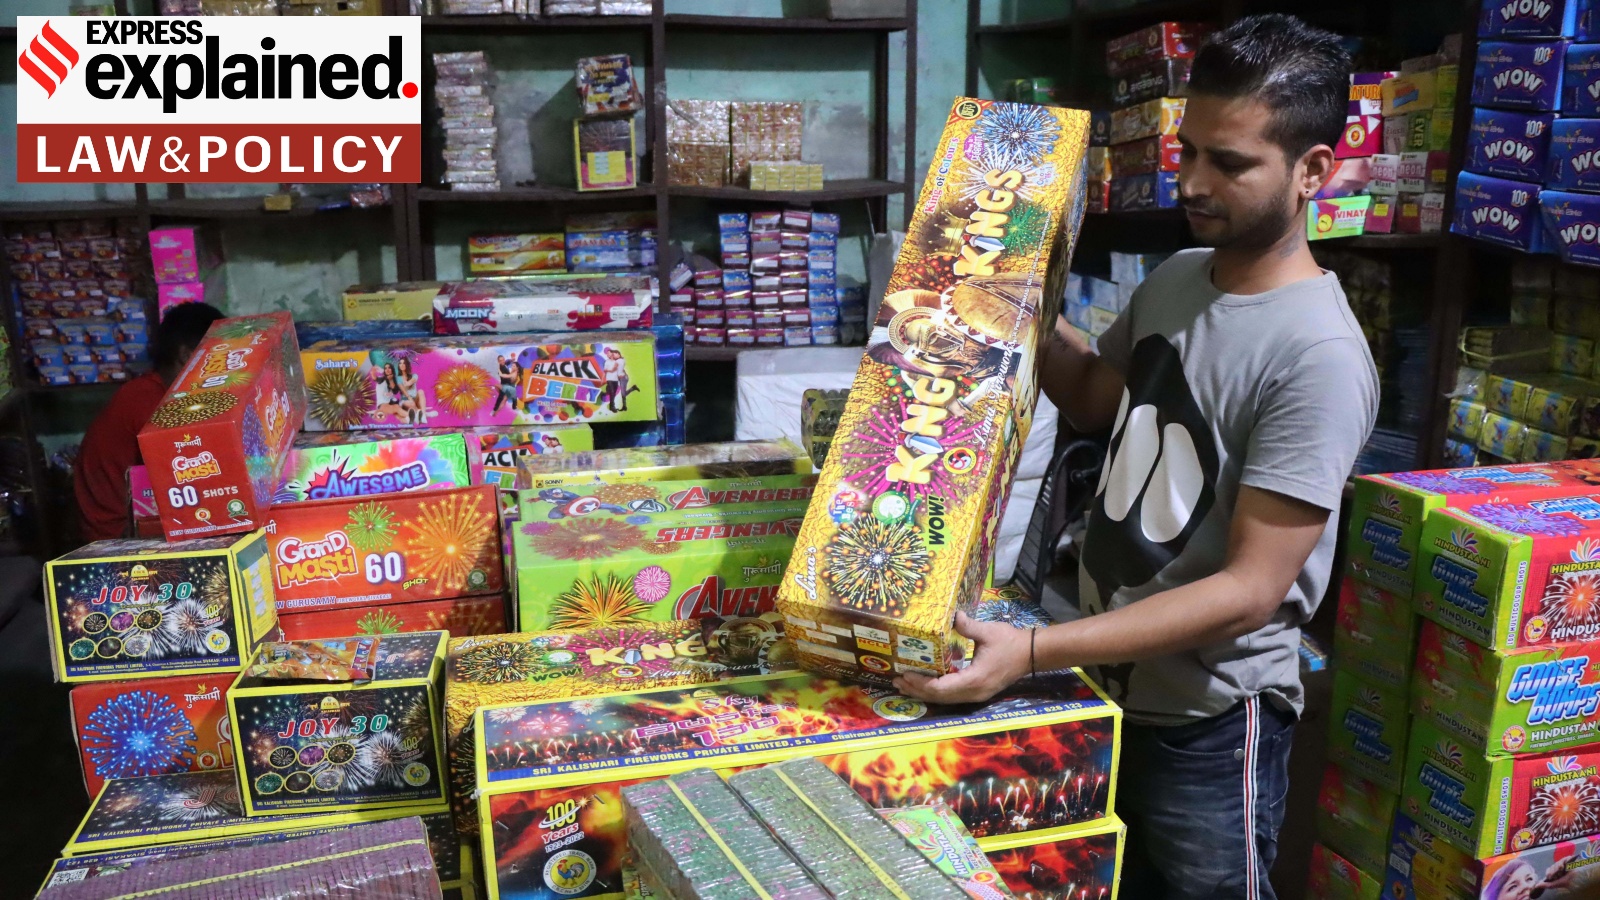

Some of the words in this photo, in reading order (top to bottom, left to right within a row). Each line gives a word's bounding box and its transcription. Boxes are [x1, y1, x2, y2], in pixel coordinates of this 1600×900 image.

[1533, 47, 1551, 65] 100
[1493, 68, 1542, 94] WOW
[1413, 117, 1425, 147] EVER
[1526, 120, 1542, 138] 100
[938, 137, 959, 175] Colours
[1484, 140, 1534, 164] WOW
[936, 176, 946, 187] of
[923, 188, 943, 214] King
[1511, 189, 1528, 207] 100
[953, 169, 1025, 277] KINGS
[1471, 206, 1520, 233] WOW
[445, 307, 491, 319] MOON
[315, 359, 359, 371] Sahara's
[532, 359, 600, 380] BLACK
[525, 376, 600, 404] BERRY
[885, 377, 956, 484] KING
[972, 405, 996, 450] Lima
[310, 464, 430, 499] AWESOME
[168, 485, 199, 508] 60
[202, 485, 239, 498] SHOTS
[927, 494, 946, 546] WOW!
[277, 530, 349, 567] GranD
[1434, 537, 1491, 568] HINDUSTAANI
[276, 548, 358, 590] Masti
[364, 551, 403, 584] 60
[794, 546, 818, 600] Lima's
[92, 584, 149, 605] JOY
[157, 581, 193, 601] 30
[403, 578, 430, 591] SHOT
[1509, 584, 1523, 632] MULTICOLOUR
[1518, 561, 1528, 584] SHOTS
[286, 596, 336, 608] GURUSAMY
[1439, 605, 1491, 635] HINDUSTAN
[585, 641, 708, 667] KING
[532, 667, 584, 683] WOW!
[1506, 656, 1590, 704] GOOSE
[278, 717, 340, 739] JOY
[350, 714, 389, 734] 30
[532, 767, 552, 776] SRI
[556, 759, 620, 775] KALISWARI
[624, 751, 690, 767] FIREWORKS
[694, 744, 741, 759] PRIVATE
[745, 739, 794, 754] LIMITED,
[832, 730, 877, 741] Chairman
[936, 720, 963, 729] Nadar
[963, 715, 991, 726] Road,
[992, 709, 1037, 721] SIVAKASI
[1045, 706, 1064, 714] 626
[1064, 702, 1083, 711] 123
[1436, 710, 1485, 742] HINDUSTAN
[1530, 720, 1597, 742] HINDUSTAN
[1422, 745, 1476, 780] HINDUSTAANI
[1532, 766, 1597, 788] HINDUSTAANI
[546, 798, 577, 829] 100
[1496, 799, 1508, 845] MULTICOLOUR
[1502, 777, 1510, 798] SHOTS
[103, 828, 143, 837] KALISWARI
[190, 819, 220, 828] PRIVATE
[541, 822, 579, 844] Years
[1424, 810, 1478, 846] HINDUSTAN
[105, 850, 146, 862] SIVAKASI
